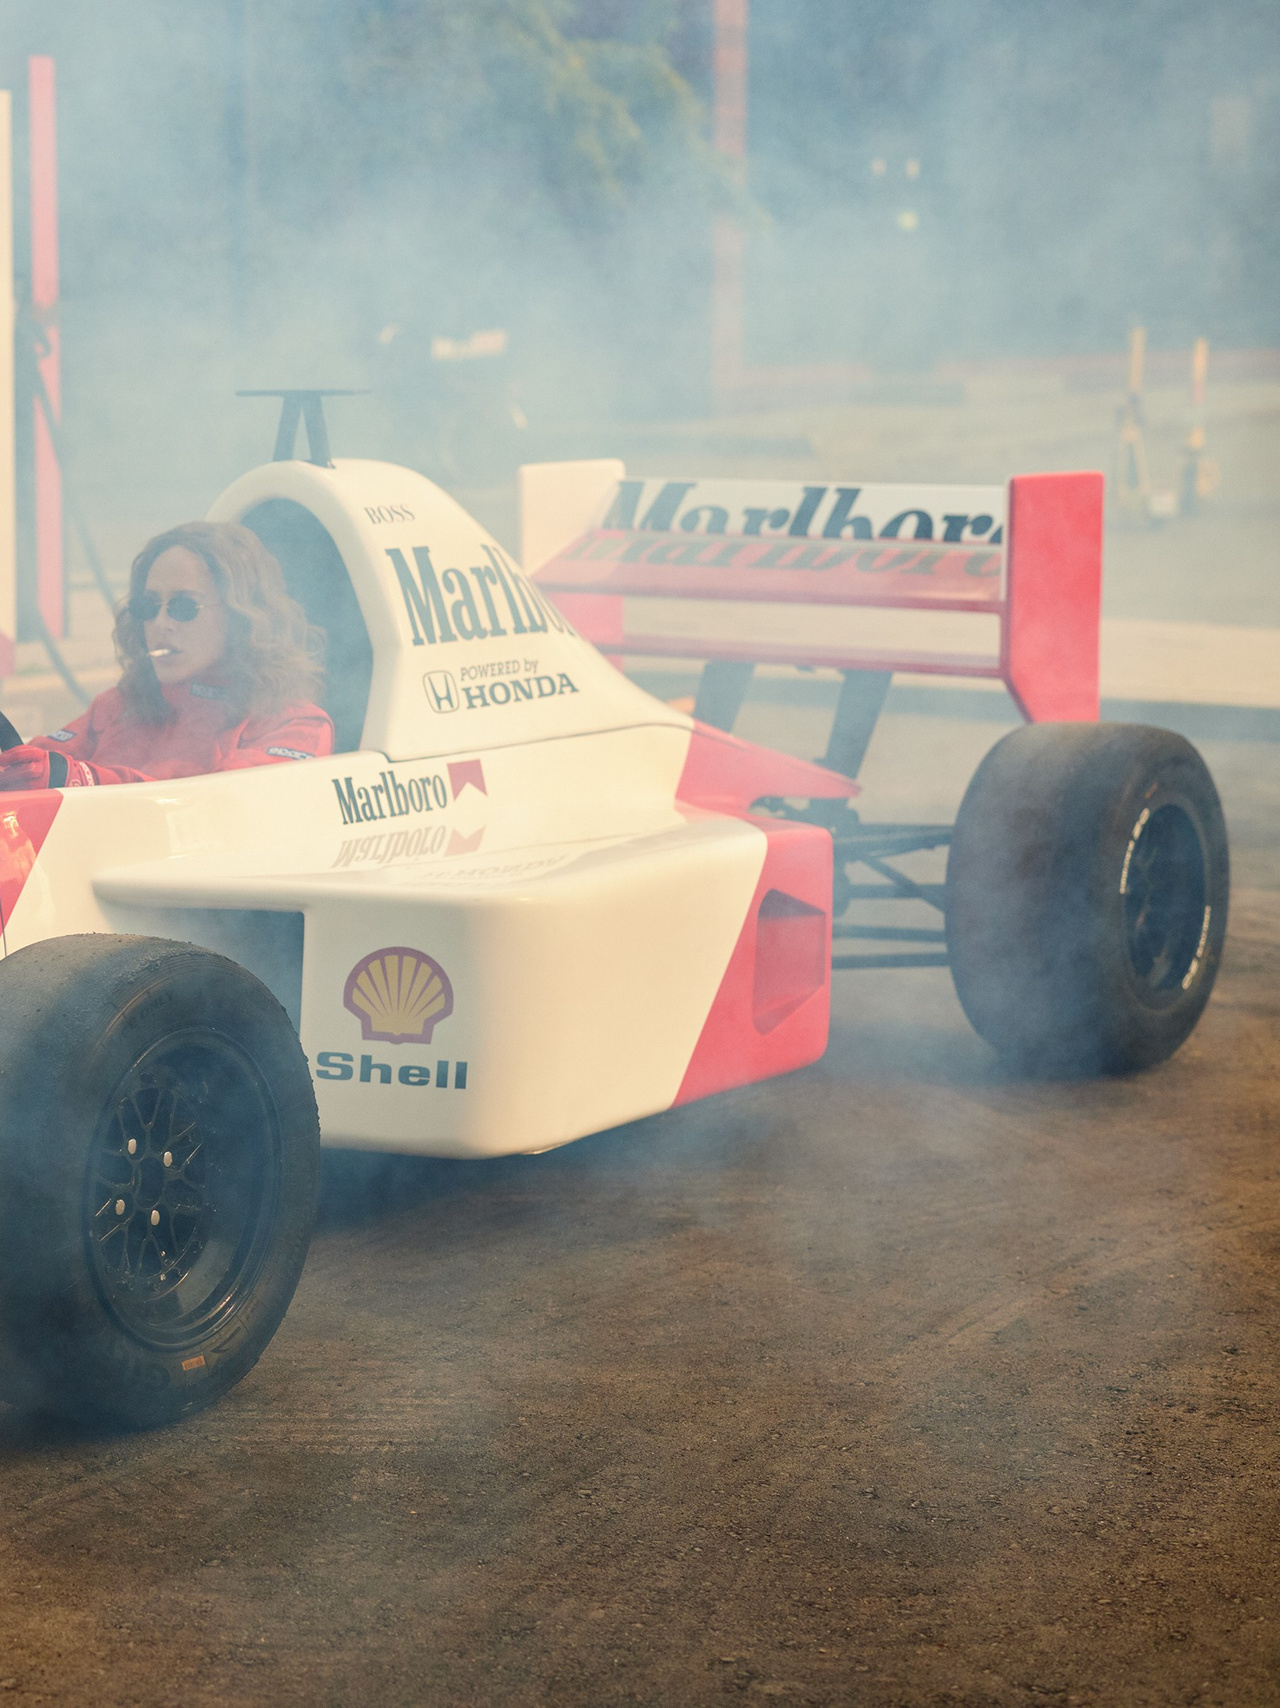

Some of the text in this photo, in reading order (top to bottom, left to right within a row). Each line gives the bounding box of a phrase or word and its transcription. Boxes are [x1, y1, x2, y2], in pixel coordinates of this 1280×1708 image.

[364, 504, 416, 525] BOSS
[460, 658, 539, 682] POWERED by
[461, 673, 580, 710] HONDA
[331, 770, 448, 825] Marlboro
[315, 1051, 468, 1089] Shell
